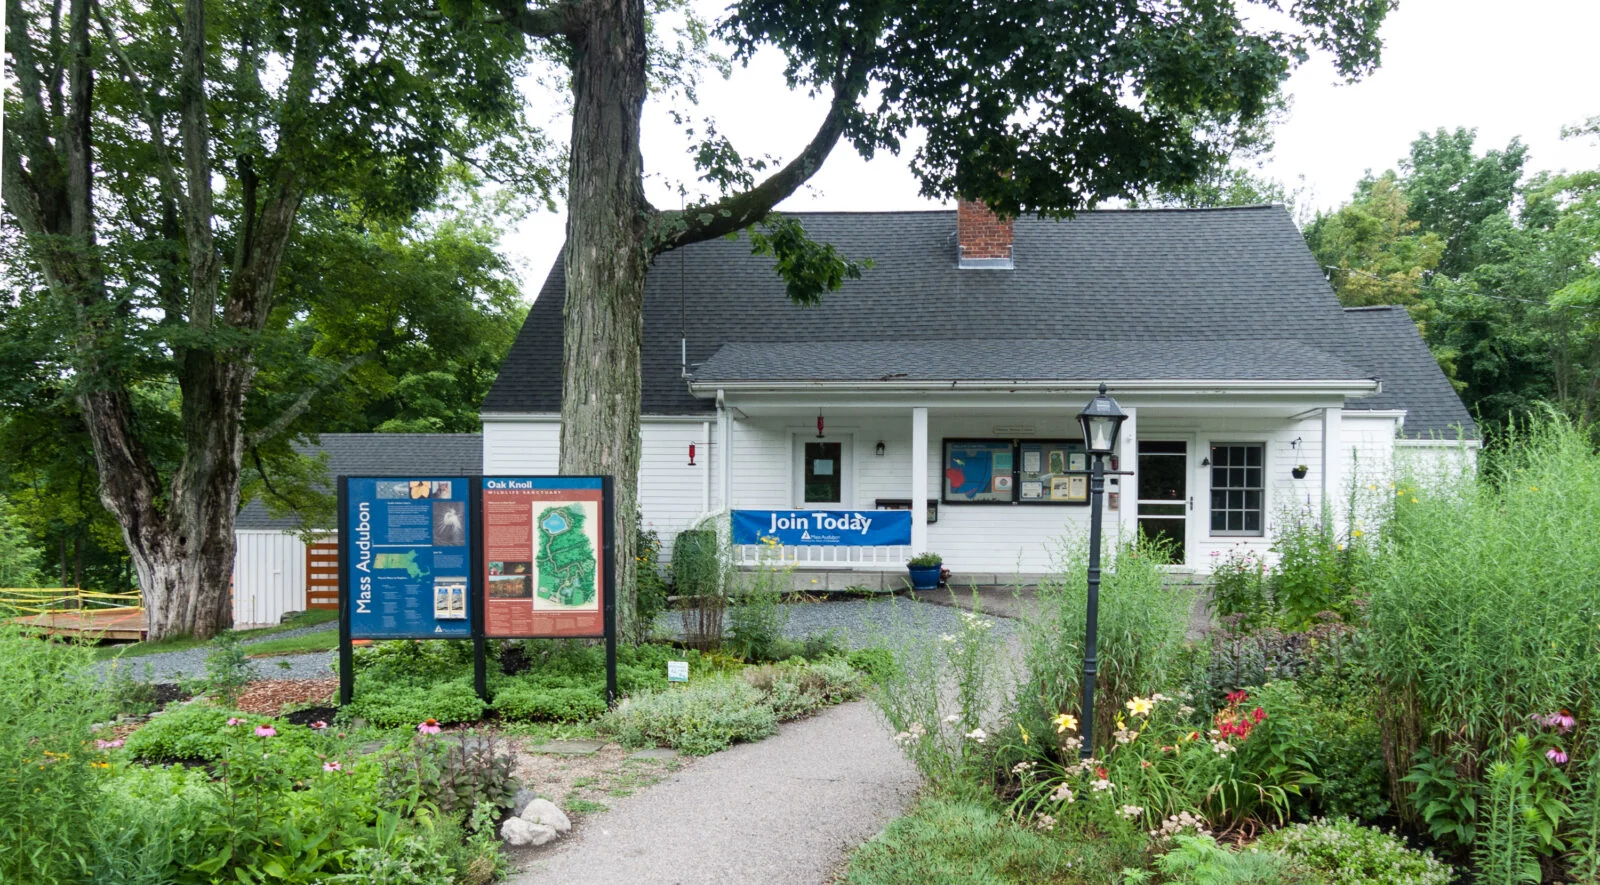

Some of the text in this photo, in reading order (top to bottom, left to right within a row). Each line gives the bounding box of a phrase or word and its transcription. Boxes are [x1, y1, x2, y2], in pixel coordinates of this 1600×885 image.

[487, 480, 533, 489] Oak Knoll
[769, 513, 872, 535] Join Today
[355, 502, 372, 614] Mass Audubon
